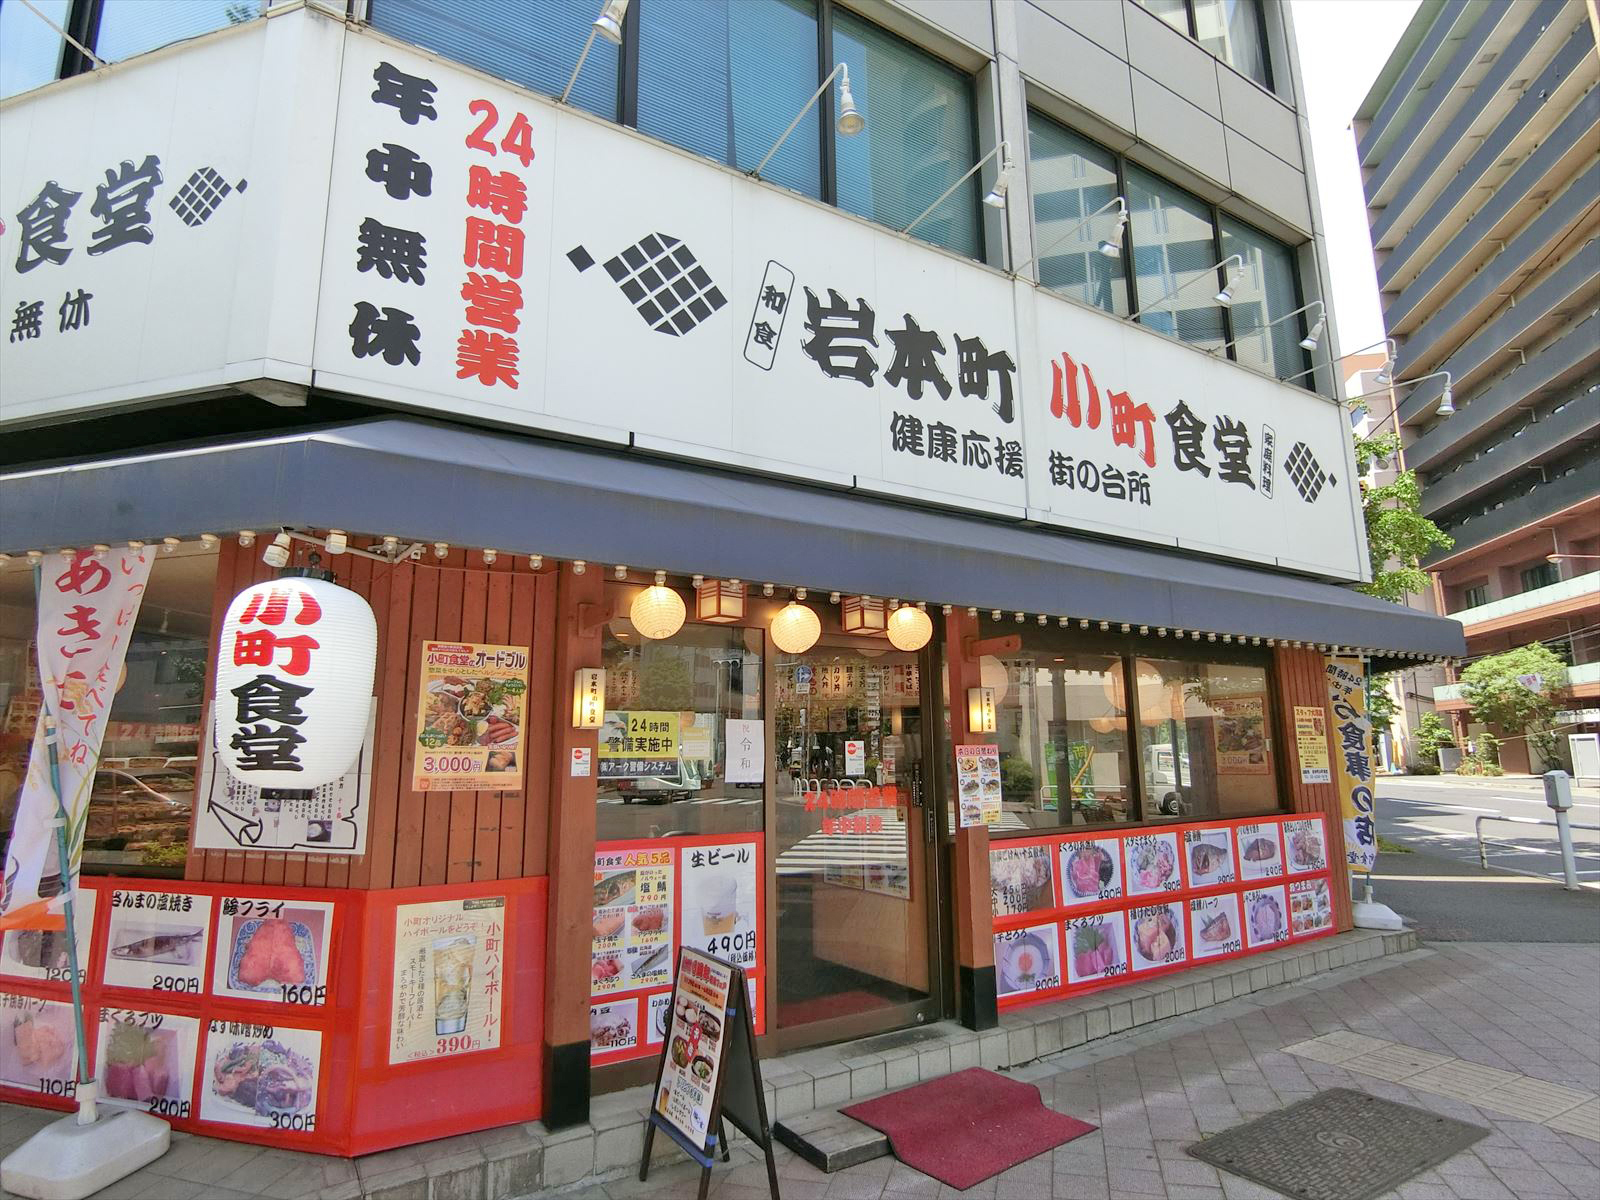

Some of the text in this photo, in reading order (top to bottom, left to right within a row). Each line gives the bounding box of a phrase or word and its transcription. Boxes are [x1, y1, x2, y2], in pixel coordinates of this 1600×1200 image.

[0, 154, 164, 274] 食堂
[349, 61, 438, 367] 年中無休
[456, 98, 535, 390] 24時間営業
[9, 288, 94, 343] 無休
[753, 284, 787, 350] 和食
[800, 285, 1256, 491] 岩本町 小町食堂
[890, 410, 1024, 480] 健康応援
[1048, 449, 1151, 506] 街の台所
[230, 587, 322, 772] 小町食堂
[631, 718, 670, 733] 24時間
[607, 736, 673, 753] 警備実施中
[424, 756, 481, 773] 3,000円
[594, 851, 671, 867] 町食堂 人気5品
[691, 847, 750, 868] 生ビール
[112, 890, 192, 912] さんまの塩焼き
[708, 930, 756, 954] 490円
[1165, 947, 1185, 963] 200円
[1104, 962, 1127, 977] 290円
[153, 975, 199, 993] 290円
[1036, 975, 1059, 991] 200円
[281, 983, 326, 1006] 160円
[437, 1034, 481, 1055] 390円
[610, 1036, 637, 1048] 110円
[39, 1078, 77, 1098] 110円
[151, 1096, 191, 1118] 290円
[269, 1111, 316, 1132] 300円
